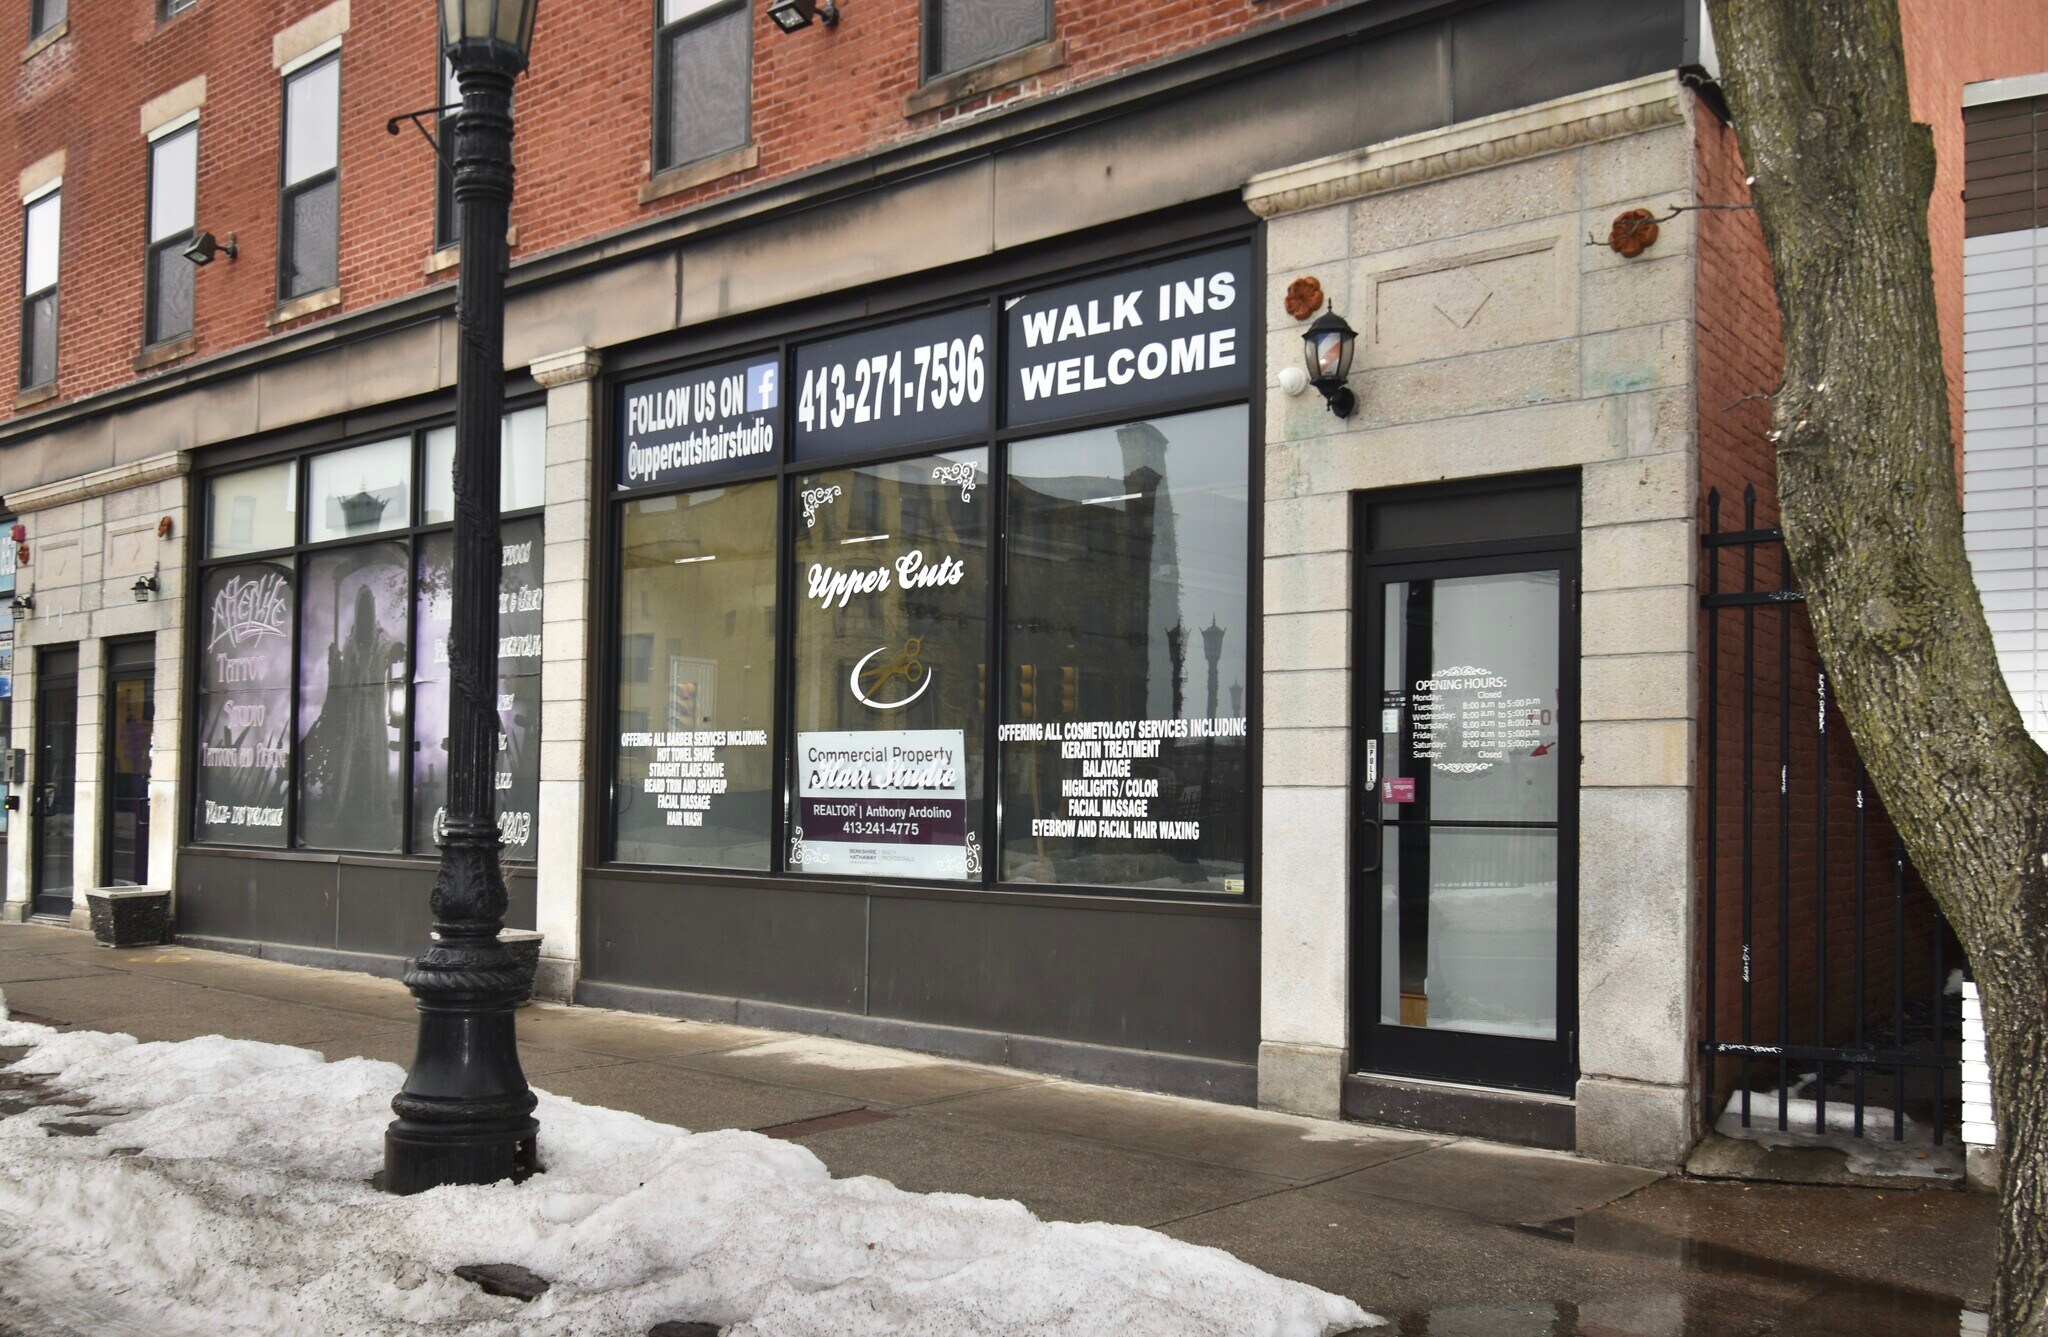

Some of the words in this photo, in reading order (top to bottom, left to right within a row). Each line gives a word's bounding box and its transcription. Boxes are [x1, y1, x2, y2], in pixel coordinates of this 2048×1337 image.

[1022, 290, 1143, 348] WALK
[1159, 271, 1236, 321] INS
[1020, 328, 1236, 401] WELCOME
[798, 334, 985, 432] 413-271-7596
[628, 386, 691, 436] FOLLOW
[694, 380, 716, 423] US
[719, 374, 744, 418] ON
[628, 417, 773, 481] @uppercutshairstudio
[808, 563, 891, 609] Upper
[895, 550, 964, 589] Cuts
[1415, 680, 1462, 690] OPENING
[1464, 677, 1507, 689] HOURS:
[1412, 694, 1442, 702] Monday:
[1477, 691, 1502, 699] Closed
[1413, 703, 1445, 711] Tuesday:
[1507, 700, 1525, 708] 5:00
[1525, 698, 1540, 706] p.m
[1412, 713, 1456, 721] Wednesday:
[1462, 711, 1479, 719] 8:00
[1507, 709, 1525, 718] 5:00
[1525, 708, 1540, 716] p.m
[998, 723, 1043, 741] OFFERING
[1044, 723, 1062, 740] ALL
[1064, 721, 1136, 740] COSMETOLOGY
[1138, 719, 1188, 738] SERVICES
[1413, 722, 1448, 730] Thursday:
[1507, 719, 1525, 727] 8:00
[1525, 719, 1540, 727] p.m
[621, 732, 653, 746] OFFERING
[653, 732, 666, 746] ALL
[667, 731, 693, 746] BARBER
[694, 731, 726, 746] SERVICES
[727, 730, 767, 746] INCLUDING:
[1412, 732, 1437, 740] Friday:
[1507, 729, 1525, 737] 5:00
[1525, 729, 1540, 737] p.m
[1062, 741, 1101, 758] KERATIN
[1103, 740, 1160, 758] TREATMENT
[1413, 741, 1447, 749] Saturday:
[1507, 739, 1525, 747] 5:00
[657, 748, 671, 762] HOT
[671, 747, 692, 762] TOWEL
[694, 747, 715, 761] SHAVE
[808, 747, 887, 762] Commercial
[893, 746, 953, 765] Property
[1413, 751, 1442, 759] Sunday:
[649, 763, 680, 777] STRAIGHT
[681, 763, 702, 777] BLADE
[702, 763, 724, 777] SHAVE
[812, 757, 871, 788] Hair
[875, 756, 957, 788] Studio
[1083, 760, 1131, 778] BALAYAGE
[644, 779, 665, 793] BEARD
[666, 779, 682, 793] TRIM
[682, 779, 697, 793] AND
[697, 779, 727, 794] SHAPEUP
[1062, 779, 1119, 797] HIGHLIGHTS
[1125, 779, 1158, 797] COLOR
[657, 794, 679, 809] FACIAL
[680, 795, 710, 810] MASSAGE
[1068, 799, 1100, 817] FACIAL
[1102, 799, 1148, 817] MASSAGE
[667, 811, 683, 826] HAIR
[683, 812, 702, 826] WASH
[866, 805, 906, 820] Anthony
[909, 806, 952, 819] Ardolino
[843, 822, 919, 835] 413-241-4775
[1032, 819, 1076, 837] EYEBROW
[1077, 820, 1097, 838] AND
[1098, 820, 1131, 838] FACIAL
[1134, 821, 1157, 839] HAIR
[1159, 821, 1200, 840] WAXING
